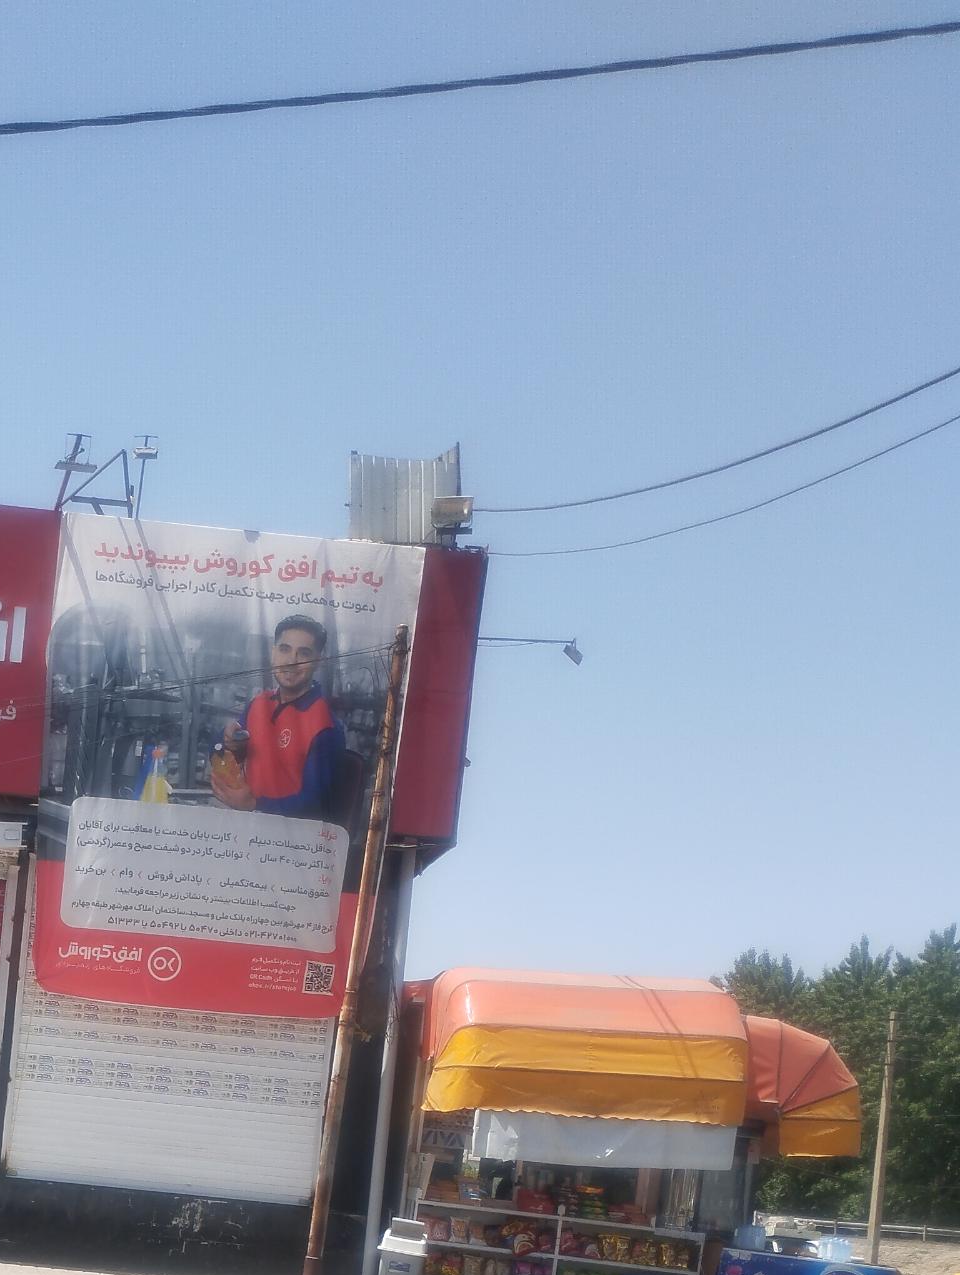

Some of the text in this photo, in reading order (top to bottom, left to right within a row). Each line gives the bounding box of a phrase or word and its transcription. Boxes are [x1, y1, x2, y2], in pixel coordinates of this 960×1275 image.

[193, 548, 275, 579] کوروش
[278, 555, 318, 582] افق
[320, 566, 358, 589] تیم
[361, 567, 384, 594] به
[155, 579, 192, 595] اجرایی
[193, 582, 217, 596] کادر
[218, 584, 256, 600] تکمیل
[256, 588, 284, 603] جهت
[286, 591, 327, 607] همکاری
[326, 598, 341, 611] به
[343, 597, 376, 613] دعوت
[103, 822, 120, 833] برای
[162, 828, 189, 837] خدمت
[211, 832, 232, 842] کارت
[133, 842, 152, 852] صبح
[259, 853, 277, 863] سال
[119, 867, 133, 878] وام
[147, 871, 173, 881] فروش
[58, 942, 143, 963] افق کوروش
